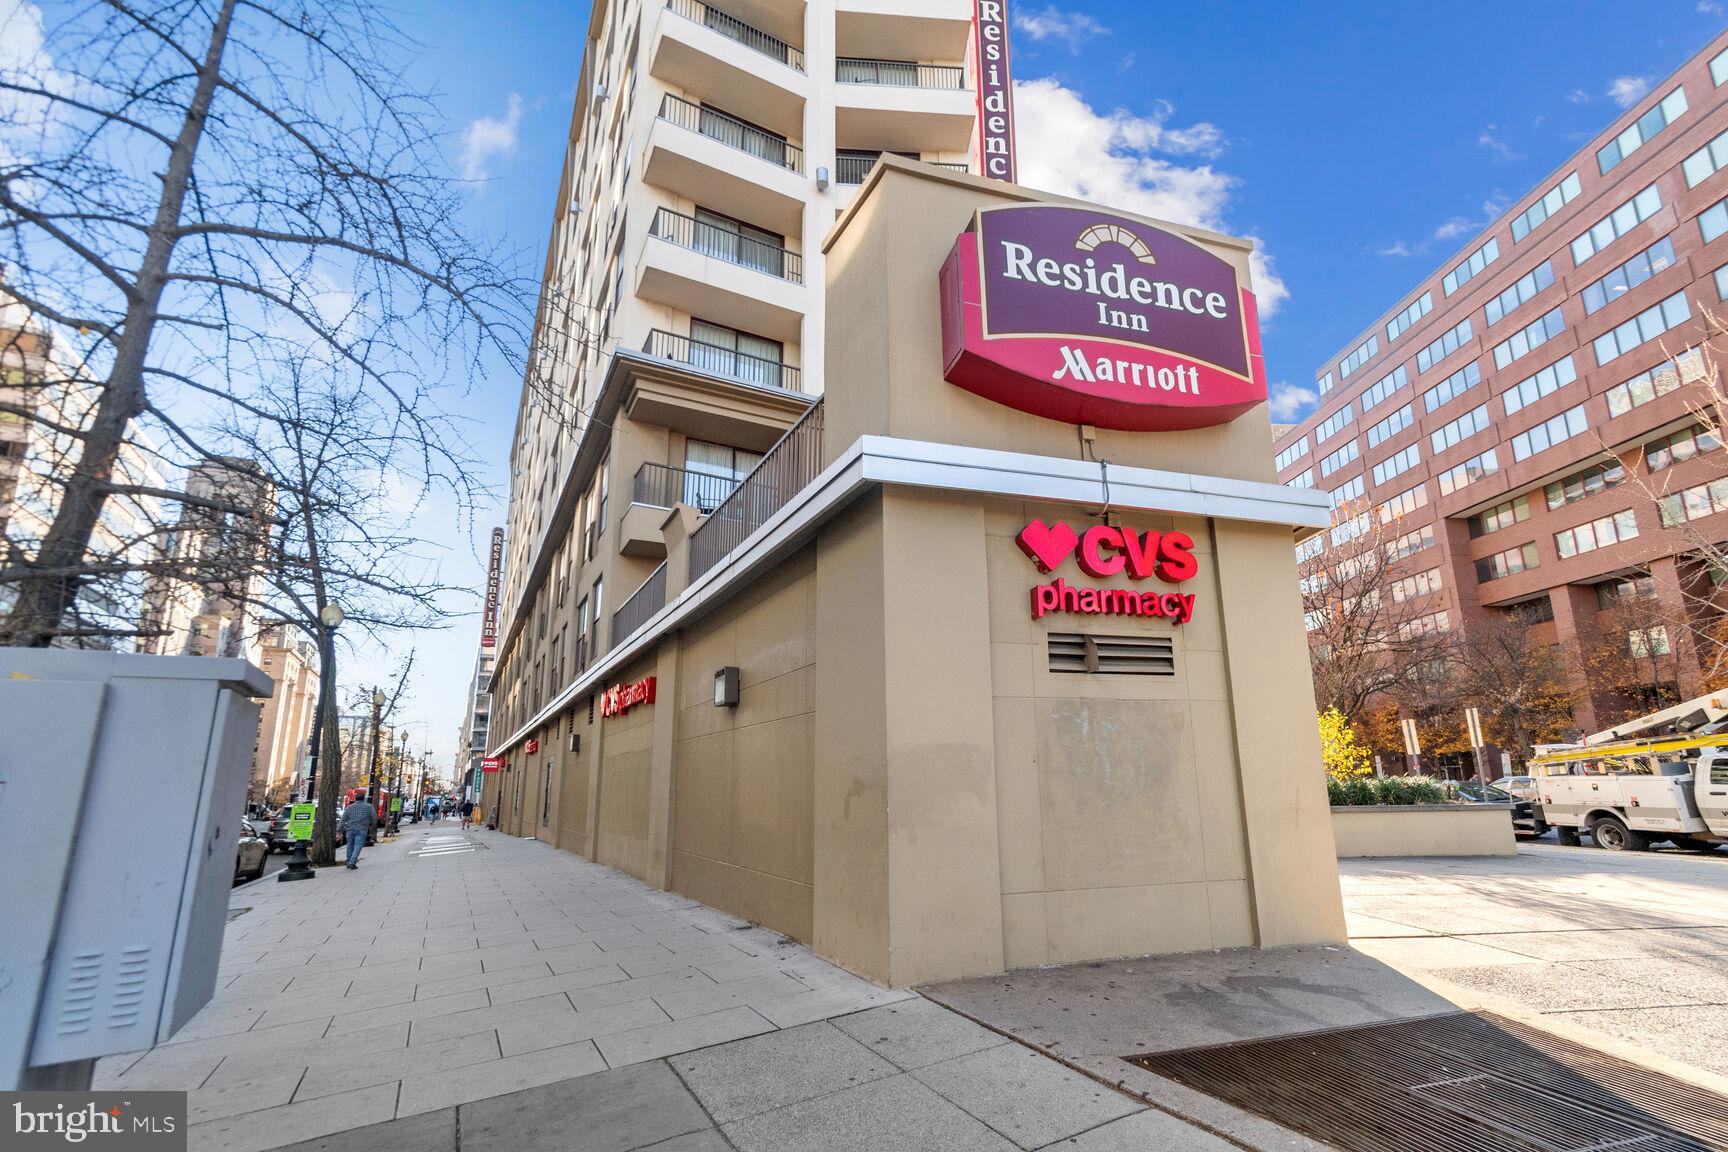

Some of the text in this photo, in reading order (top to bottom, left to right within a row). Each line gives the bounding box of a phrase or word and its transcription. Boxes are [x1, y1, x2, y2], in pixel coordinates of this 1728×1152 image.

[980, 0, 1008, 183] Residenc
[1001, 240, 1227, 319] Residence
[1098, 302, 1149, 332] Inn
[1052, 345, 1200, 395] Marriott
[488, 535, 501, 608] Residence
[1076, 525, 1198, 582] CVS
[485, 611, 493, 636] Inn
[1031, 578, 1195, 625] pharmacy
